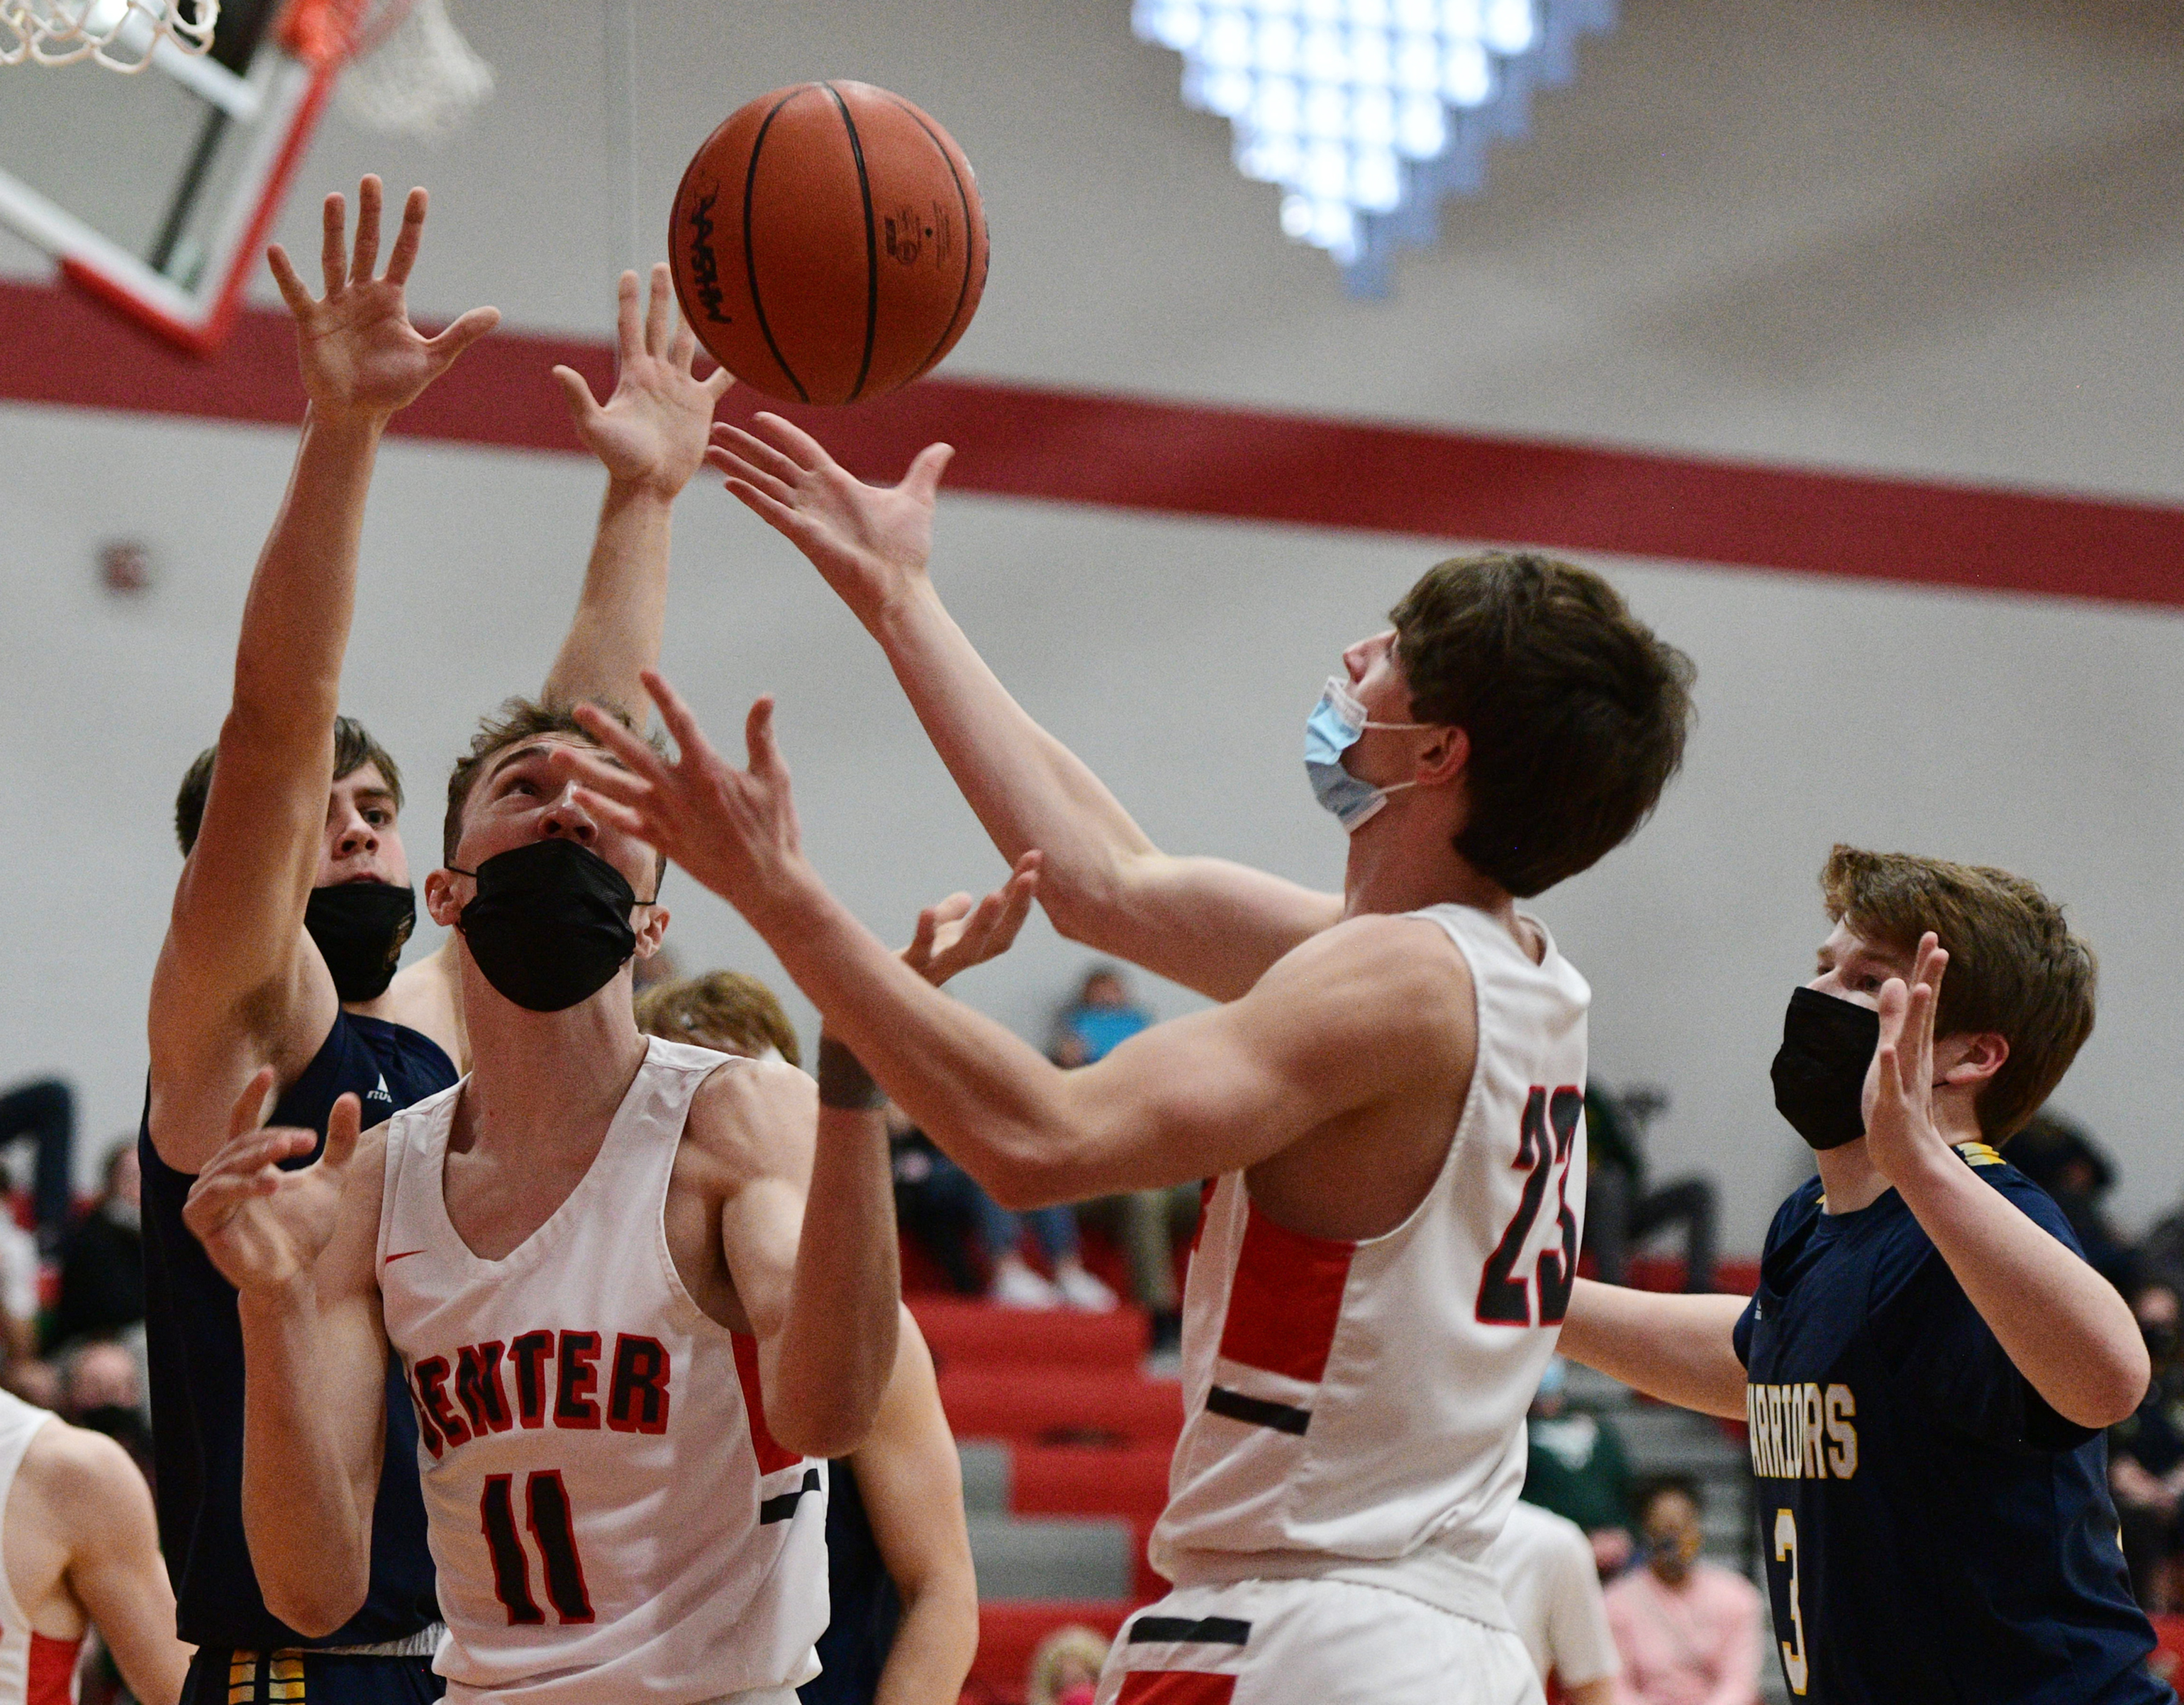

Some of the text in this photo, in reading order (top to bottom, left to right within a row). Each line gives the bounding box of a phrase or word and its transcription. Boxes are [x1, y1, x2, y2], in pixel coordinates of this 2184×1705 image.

[1475, 1085, 1584, 1328] 23
[1746, 1382, 1859, 1480] ARRIORS
[479, 1468, 596, 1627] 11
[1774, 1508, 1808, 1696] 3
